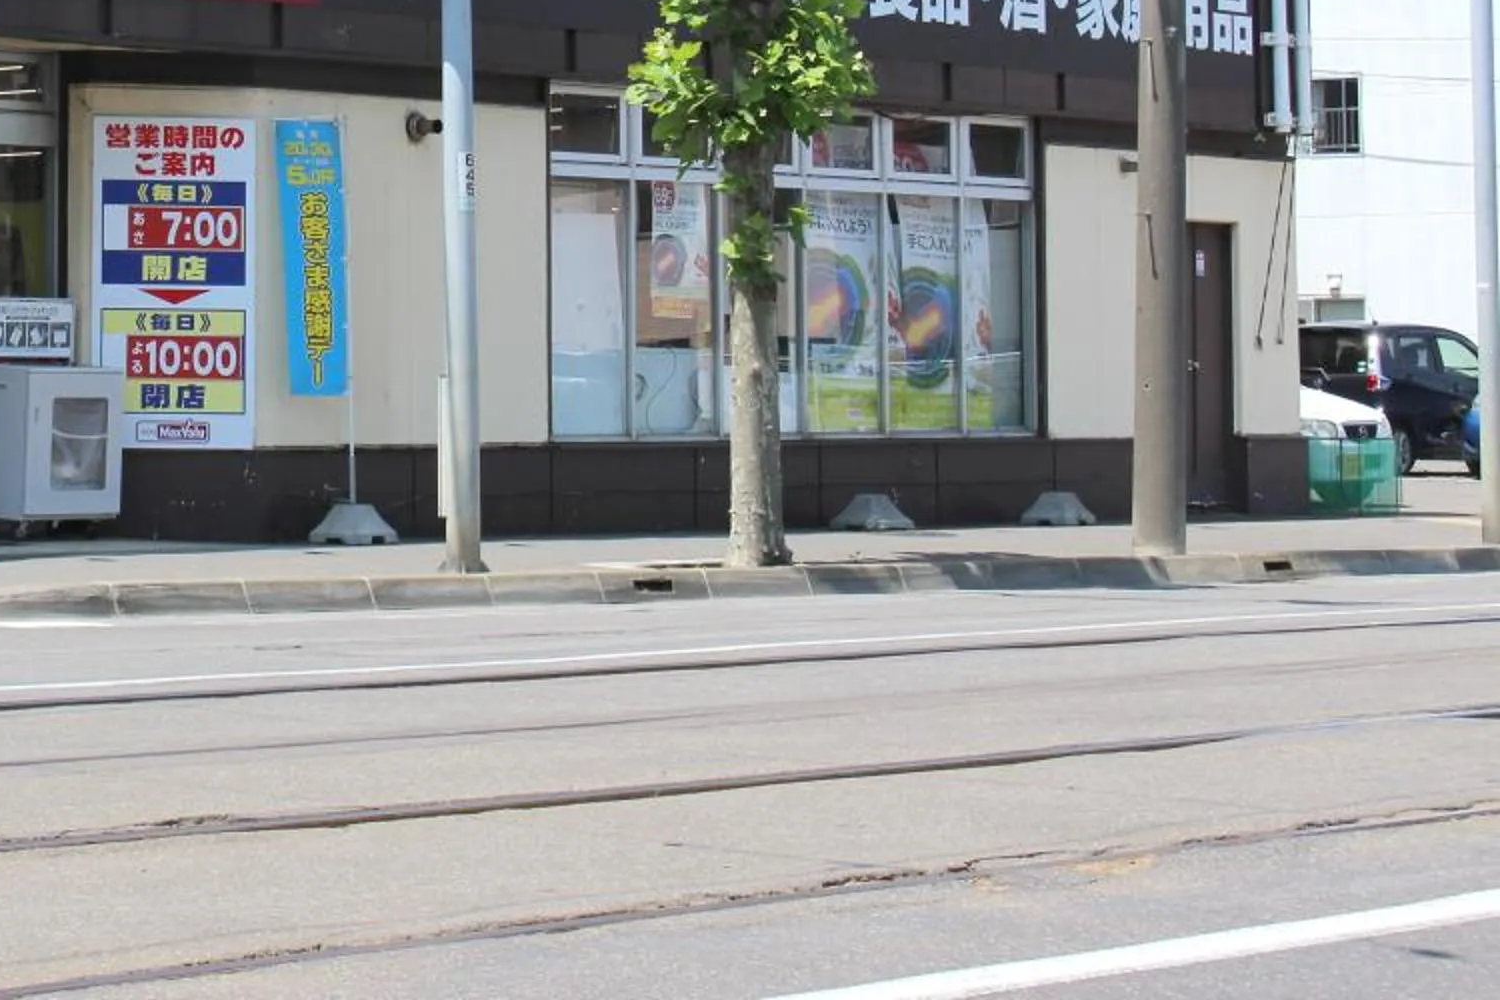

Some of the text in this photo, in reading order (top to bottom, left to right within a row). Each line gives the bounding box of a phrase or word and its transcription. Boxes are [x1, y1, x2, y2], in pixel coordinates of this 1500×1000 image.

[104, 123, 245, 150] 営業時間の
[135, 151, 216, 177] ご案内
[161, 210, 238, 247] 7:00
[141, 255, 208, 282] 開店
[145, 340, 238, 377] 10:00
[140, 383, 206, 409] 閉店
